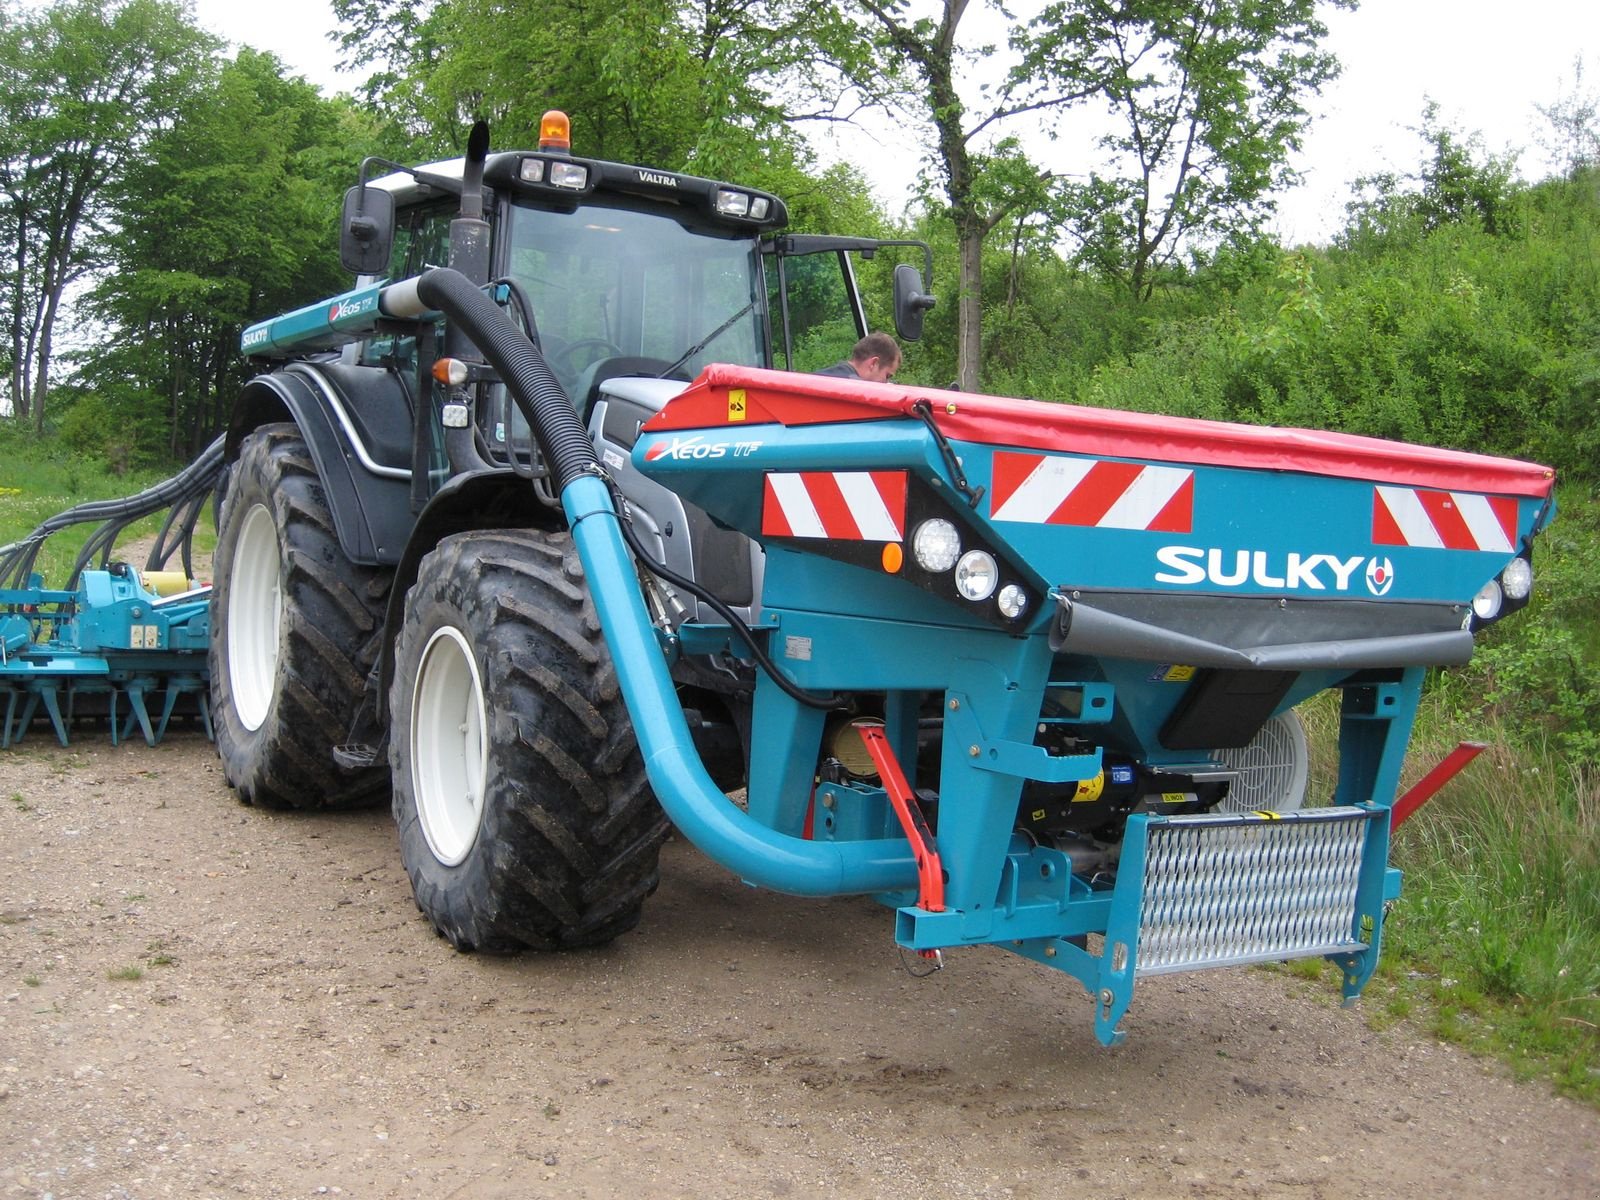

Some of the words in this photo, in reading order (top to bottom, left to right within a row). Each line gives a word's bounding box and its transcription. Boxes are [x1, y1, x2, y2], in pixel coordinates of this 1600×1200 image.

[639, 170, 677, 186] VALTRA
[243, 330, 263, 346] SULKY
[1155, 546, 1365, 590] SULKY
